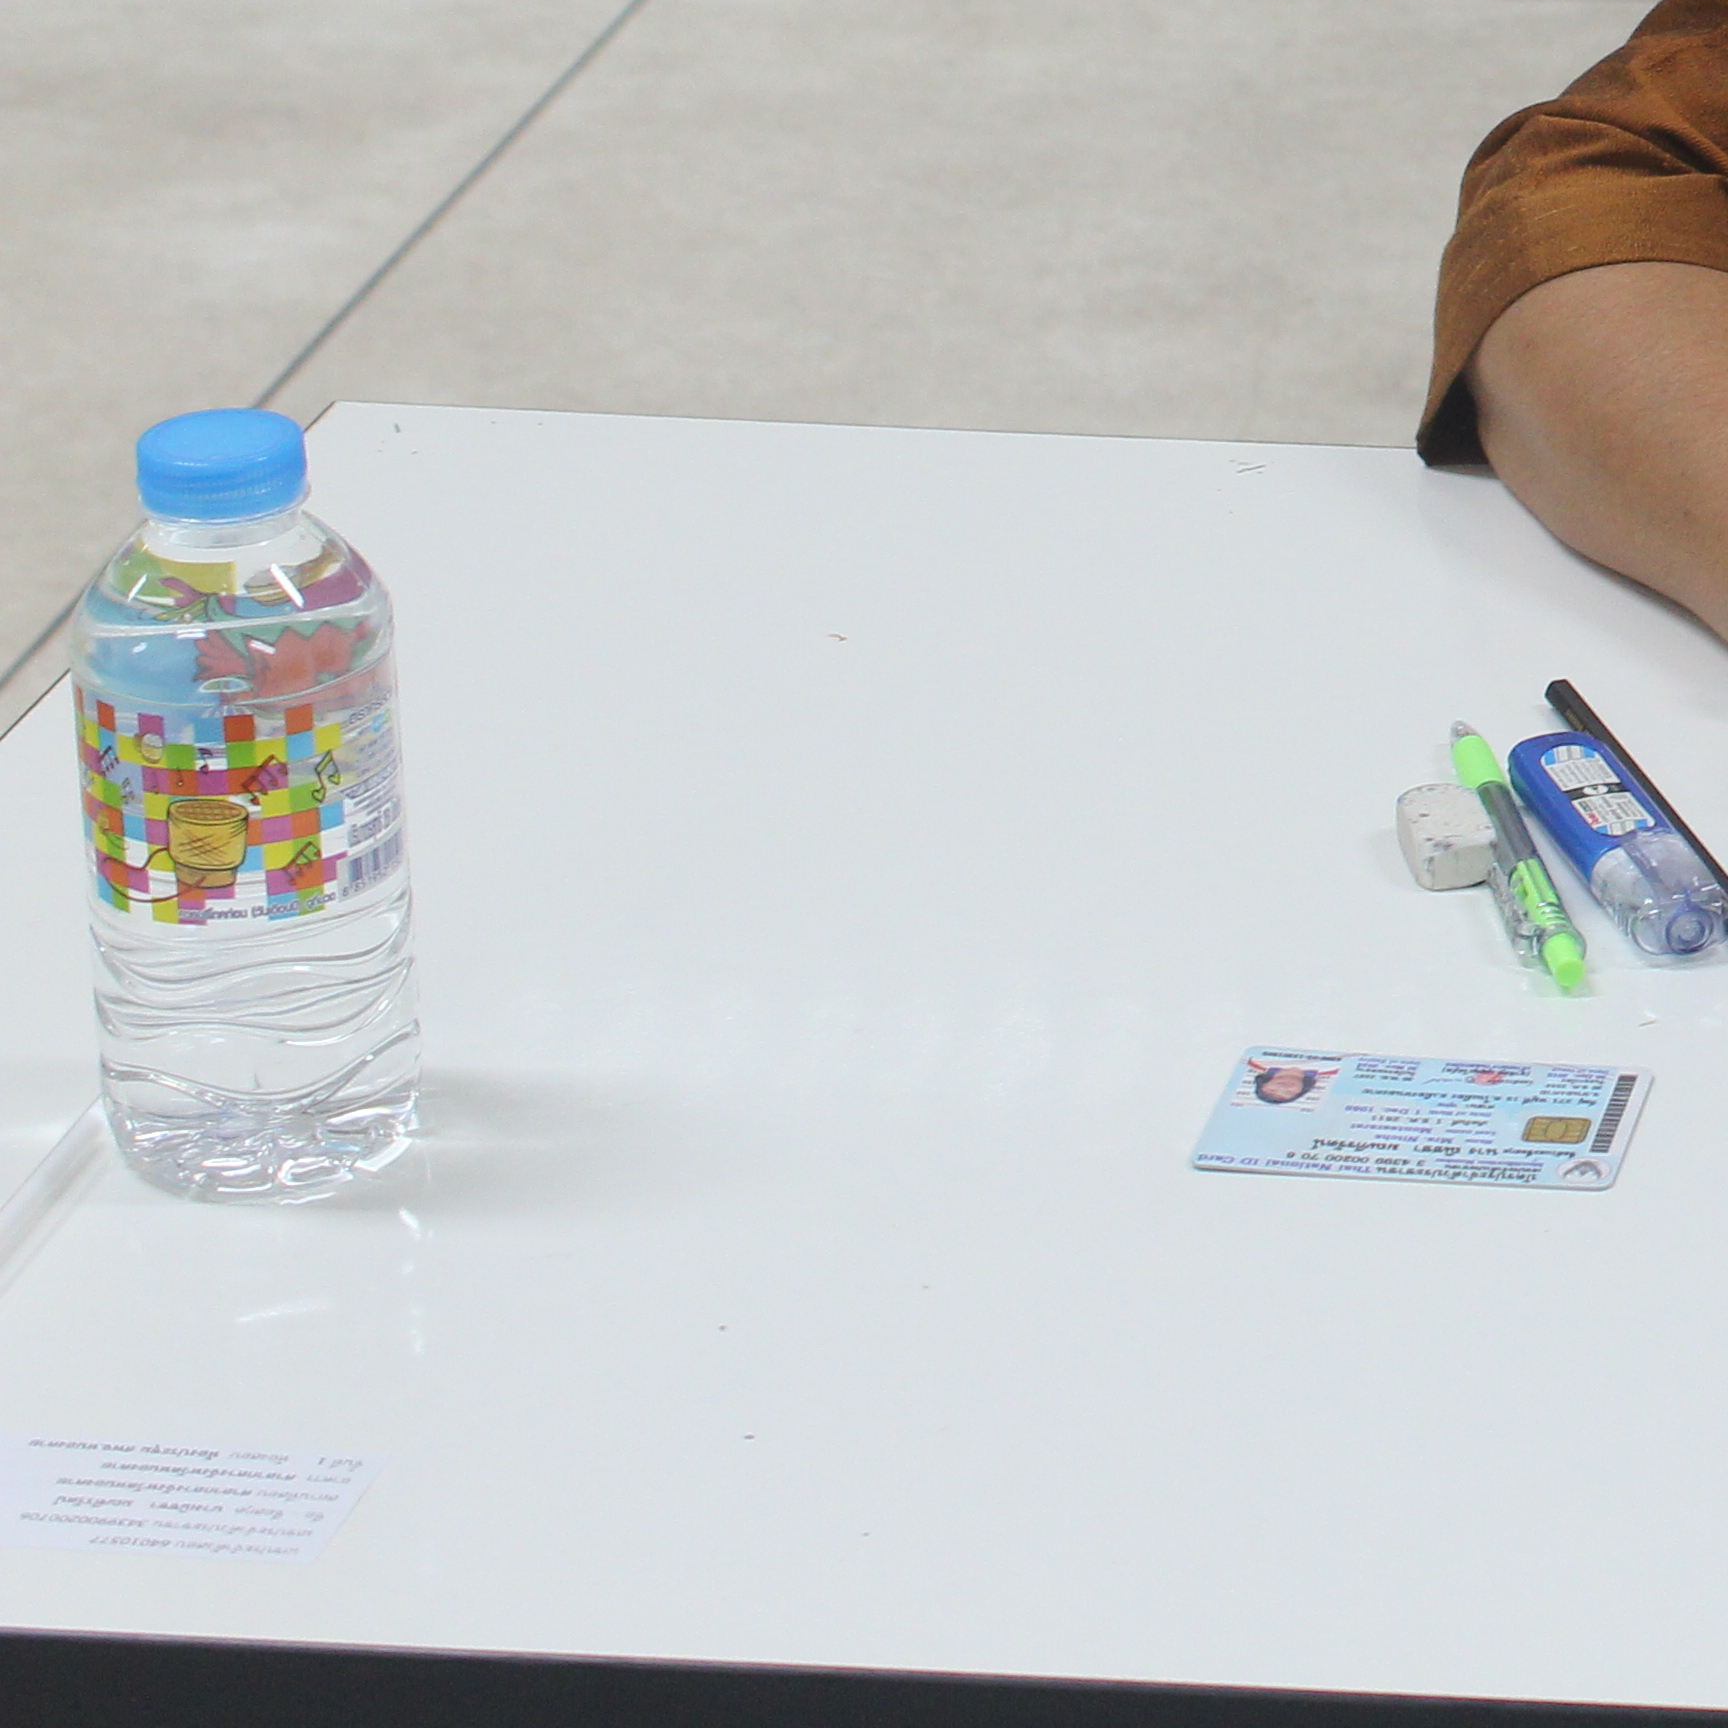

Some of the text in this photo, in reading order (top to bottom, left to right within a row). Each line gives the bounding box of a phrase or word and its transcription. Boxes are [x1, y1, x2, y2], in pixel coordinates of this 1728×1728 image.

[1300, 1152, 1320, 1160] 70
[1467, 1147, 1499, 1156] นาง
[1195, 1153, 1372, 1173] Thai National ID Card
